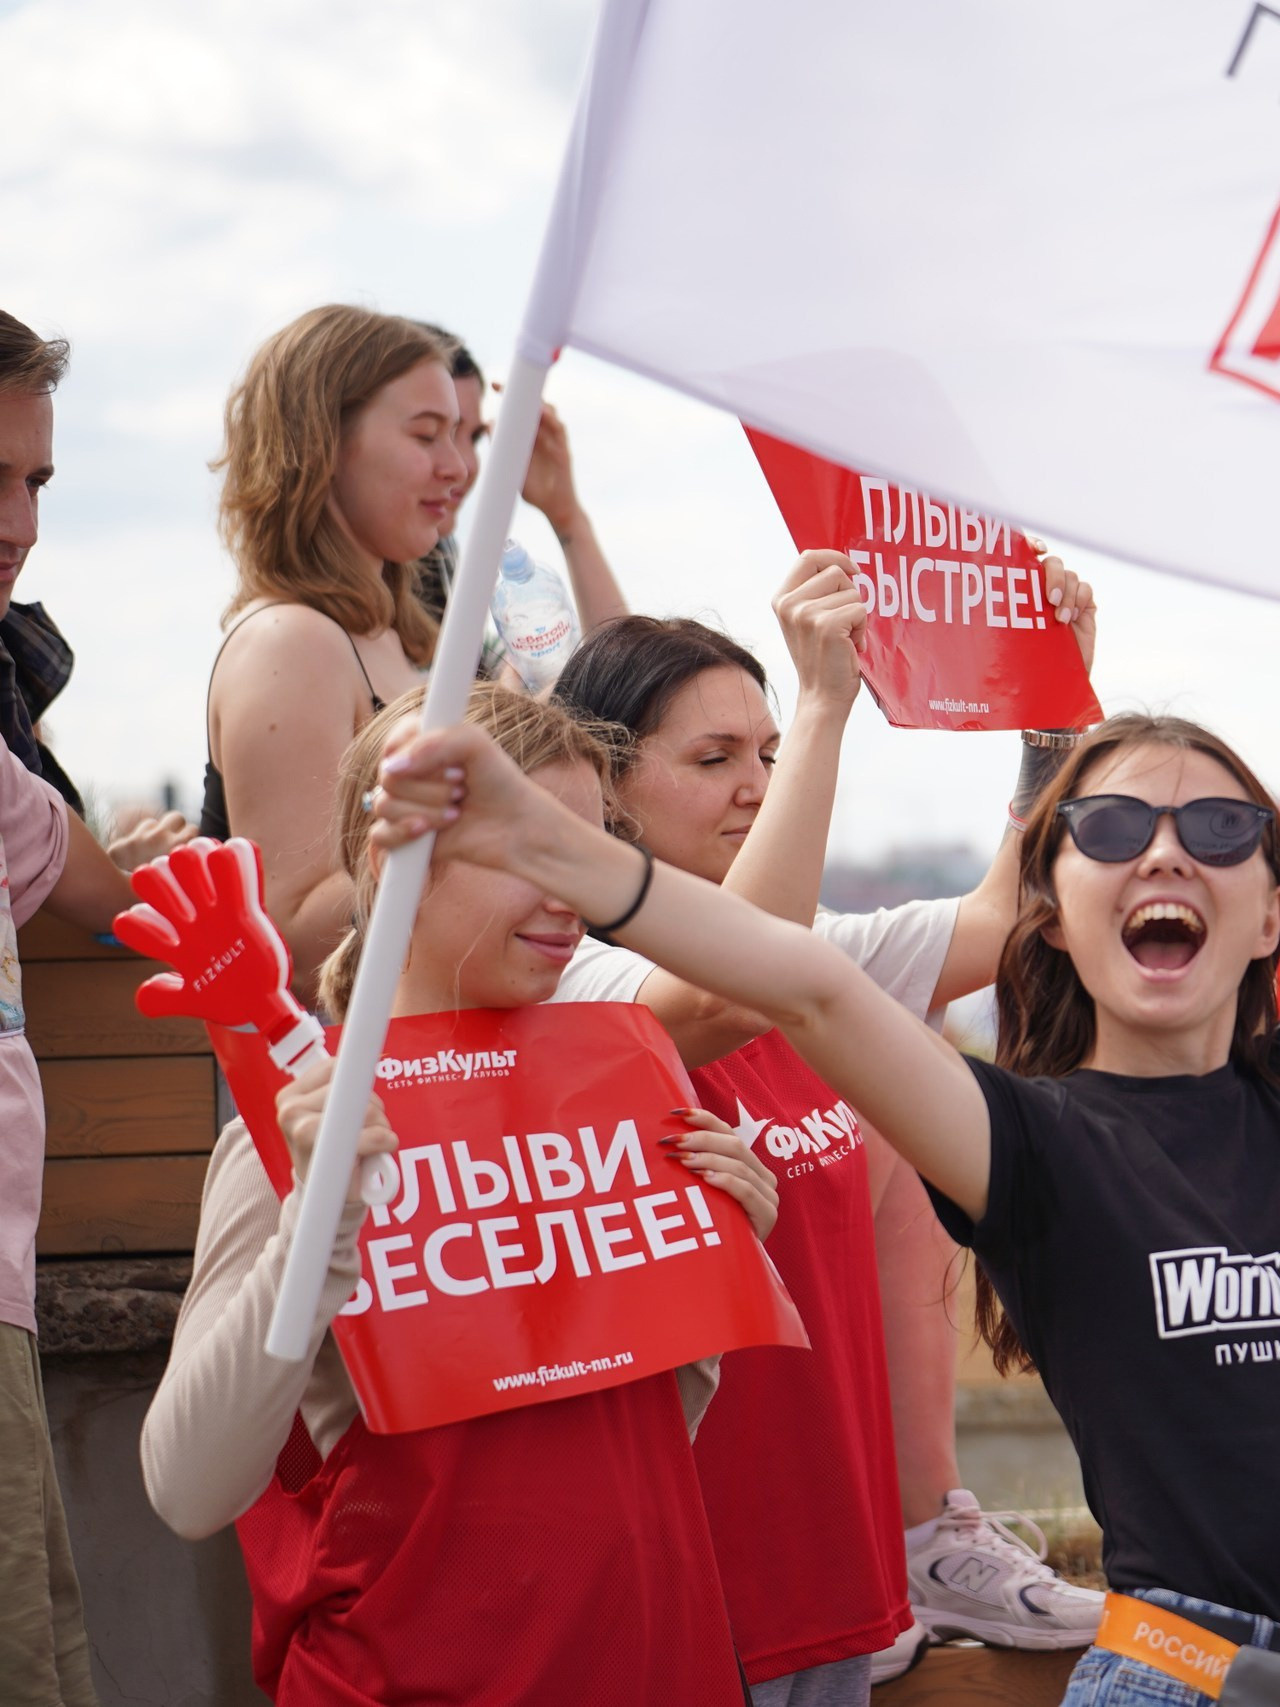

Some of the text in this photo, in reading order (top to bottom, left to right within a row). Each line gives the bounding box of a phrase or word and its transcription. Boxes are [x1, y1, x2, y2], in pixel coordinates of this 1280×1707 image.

[860, 476, 1011, 556] ПЛЫВИ
[849, 550, 1046, 629] БЫСТРЕЕ!
[929, 698, 989, 714] www.fizkult-nn.ru
[193, 938, 246, 993] FIZKULT
[375, 1050, 517, 1080] ФизКульт
[387, 1080, 413, 1090] СЕТЬ
[473, 1069, 509, 1078] КЛУБОВ
[787, 1162, 814, 1178] СЕТЬ
[493, 1351, 634, 1391] www.fizkult-nn.ru
